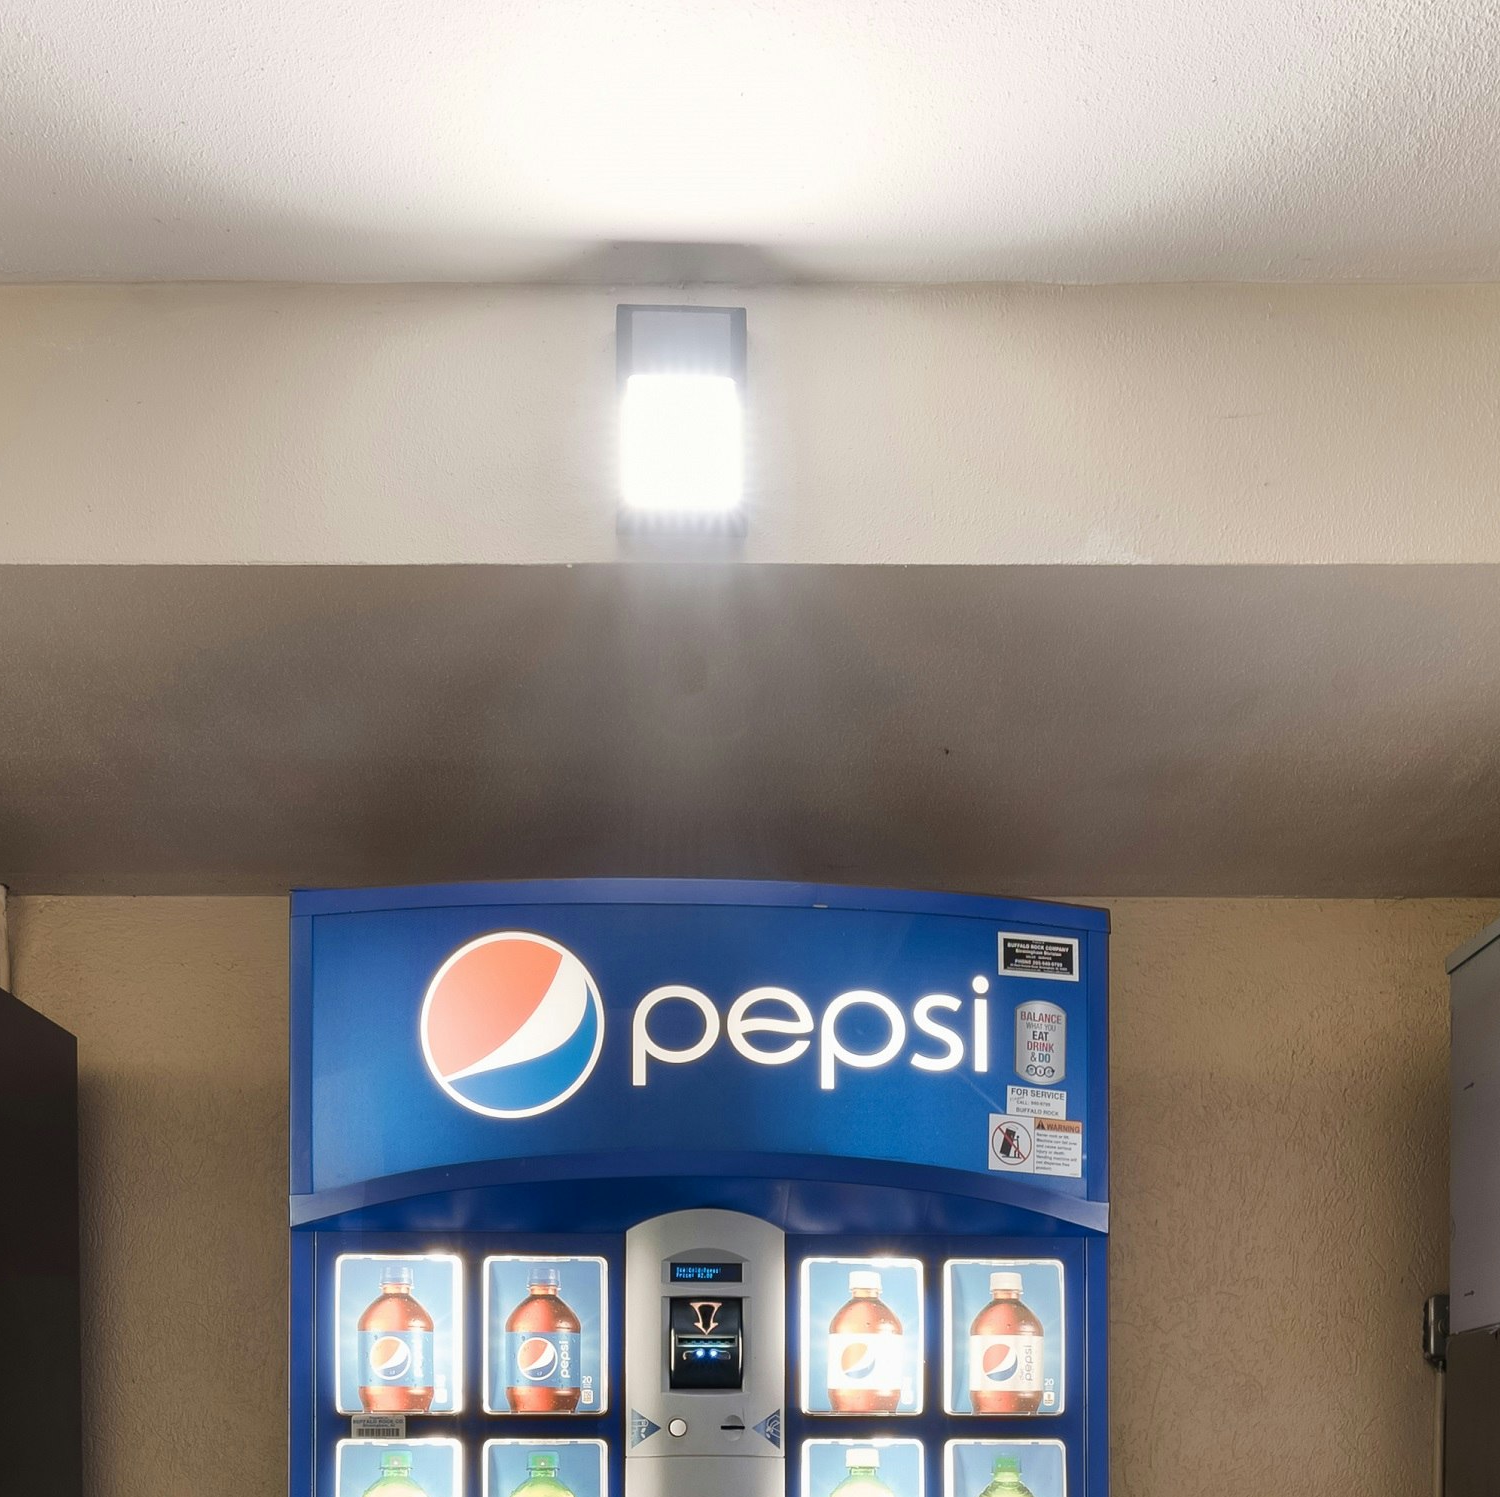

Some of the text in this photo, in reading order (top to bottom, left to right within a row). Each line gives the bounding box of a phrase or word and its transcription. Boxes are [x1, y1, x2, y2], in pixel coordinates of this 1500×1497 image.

[1020, 1010, 1062, 1024] BALANCE
[632, 975, 990, 1090] pepsi
[1026, 1022, 1057, 1032] WHAT YOU
[1032, 1031, 1049, 1041] EAT
[1027, 1040, 1054, 1052] DRINK
[1030, 1053, 1051, 1064] & DO
[1011, 1088, 1028, 1096] FOR
[1030, 1090, 1065, 1100] SERVICE
[1046, 1123, 1080, 1134] WARNING
[559, 1340, 571, 1378] pepsi
[1024, 1345, 1033, 1381] pepsi
[582, 1376, 592, 1384] 20
[1044, 1378, 1054, 1386] 20
